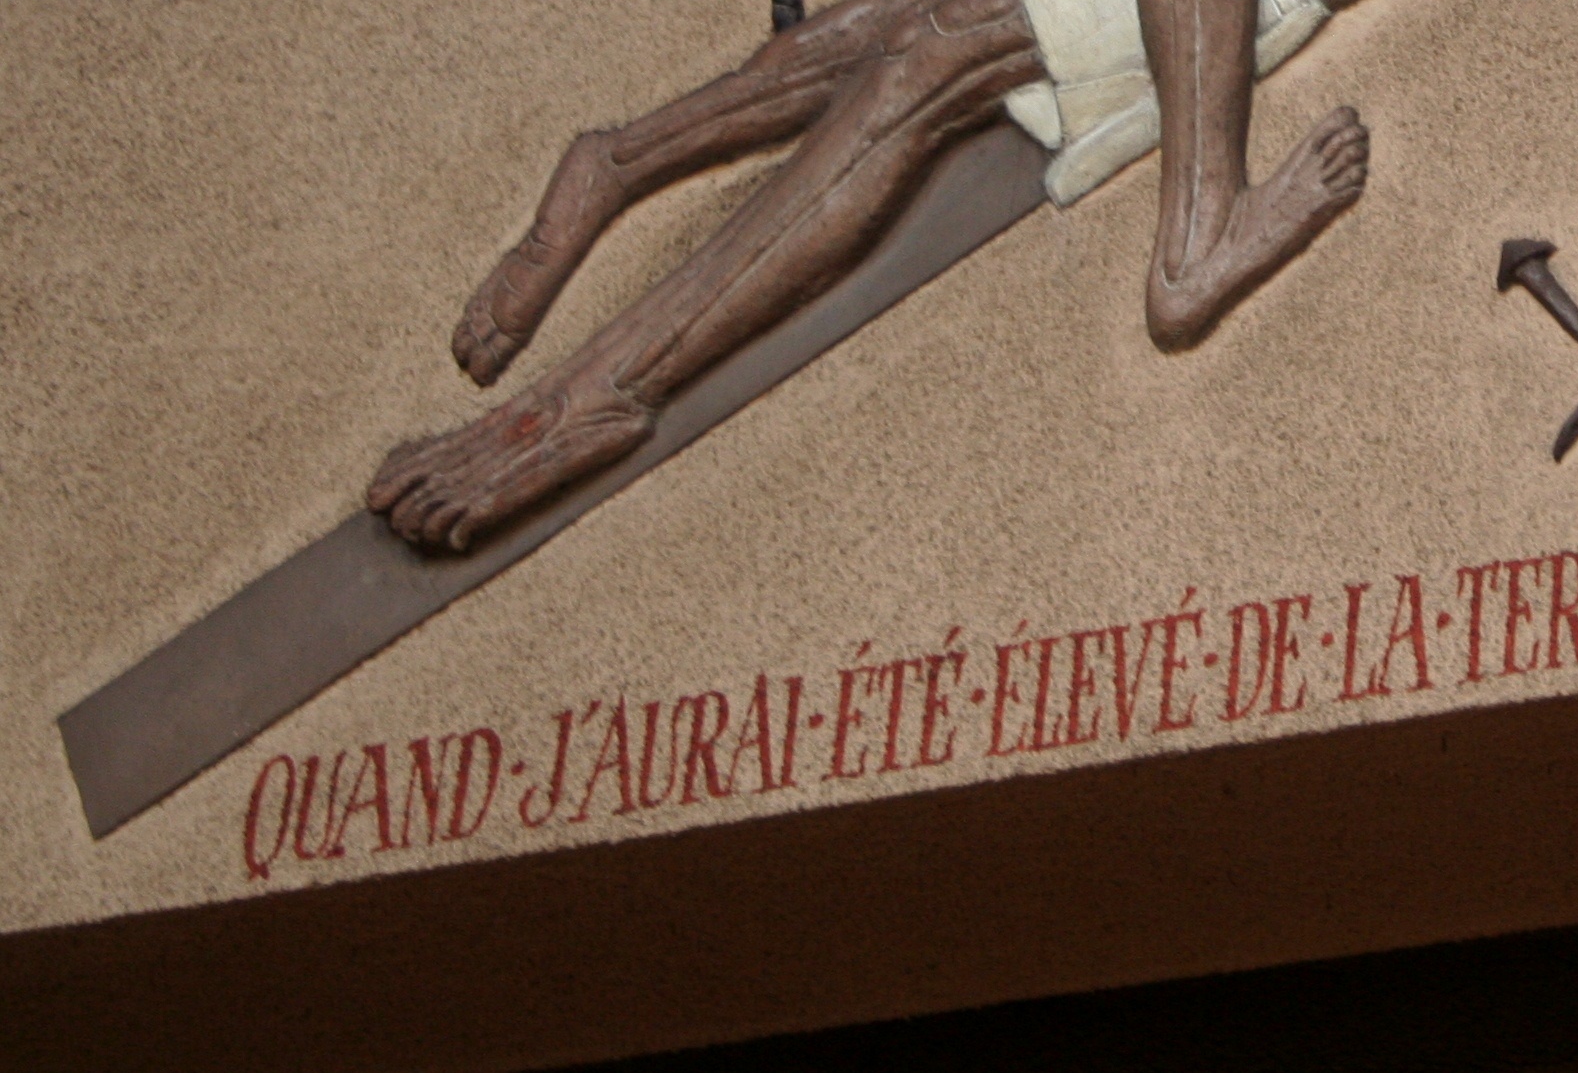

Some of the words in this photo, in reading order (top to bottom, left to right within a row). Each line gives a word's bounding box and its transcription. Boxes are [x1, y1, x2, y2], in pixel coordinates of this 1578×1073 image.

[246, 729, 501, 879] QUAND
[1222, 595, 1313, 721] DE
[1340, 576, 1433, 700] LA
